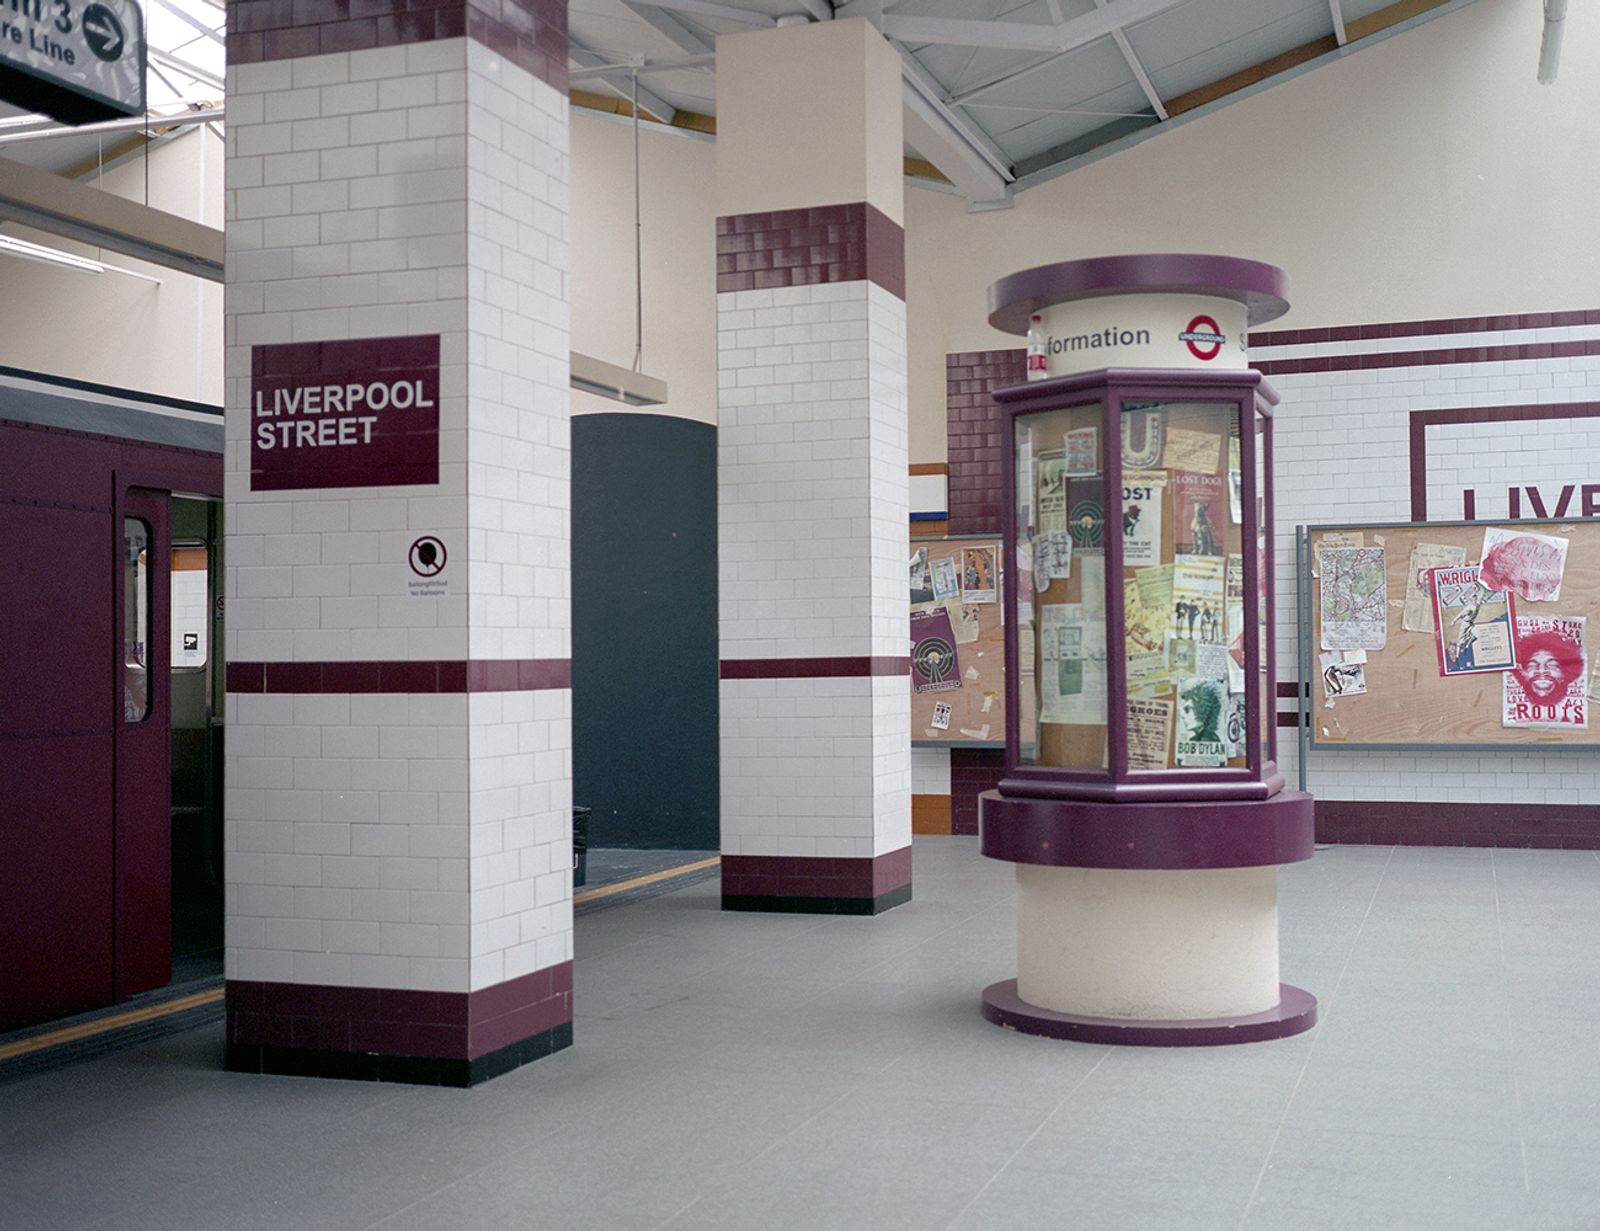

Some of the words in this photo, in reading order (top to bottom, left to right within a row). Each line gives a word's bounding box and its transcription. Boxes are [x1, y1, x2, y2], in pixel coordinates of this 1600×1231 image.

[54, 0, 72, 34] 3
[30, 28, 75, 66] Line
[256, 380, 434, 417] LIVERPOOL
[257, 416, 377, 450] STREET
[1176, 475, 1198, 484] LOST
[1517, 703, 1584, 724] ROOTS
[1178, 742, 1197, 755] BOB
[1199, 743, 1226, 755] DYLAN
